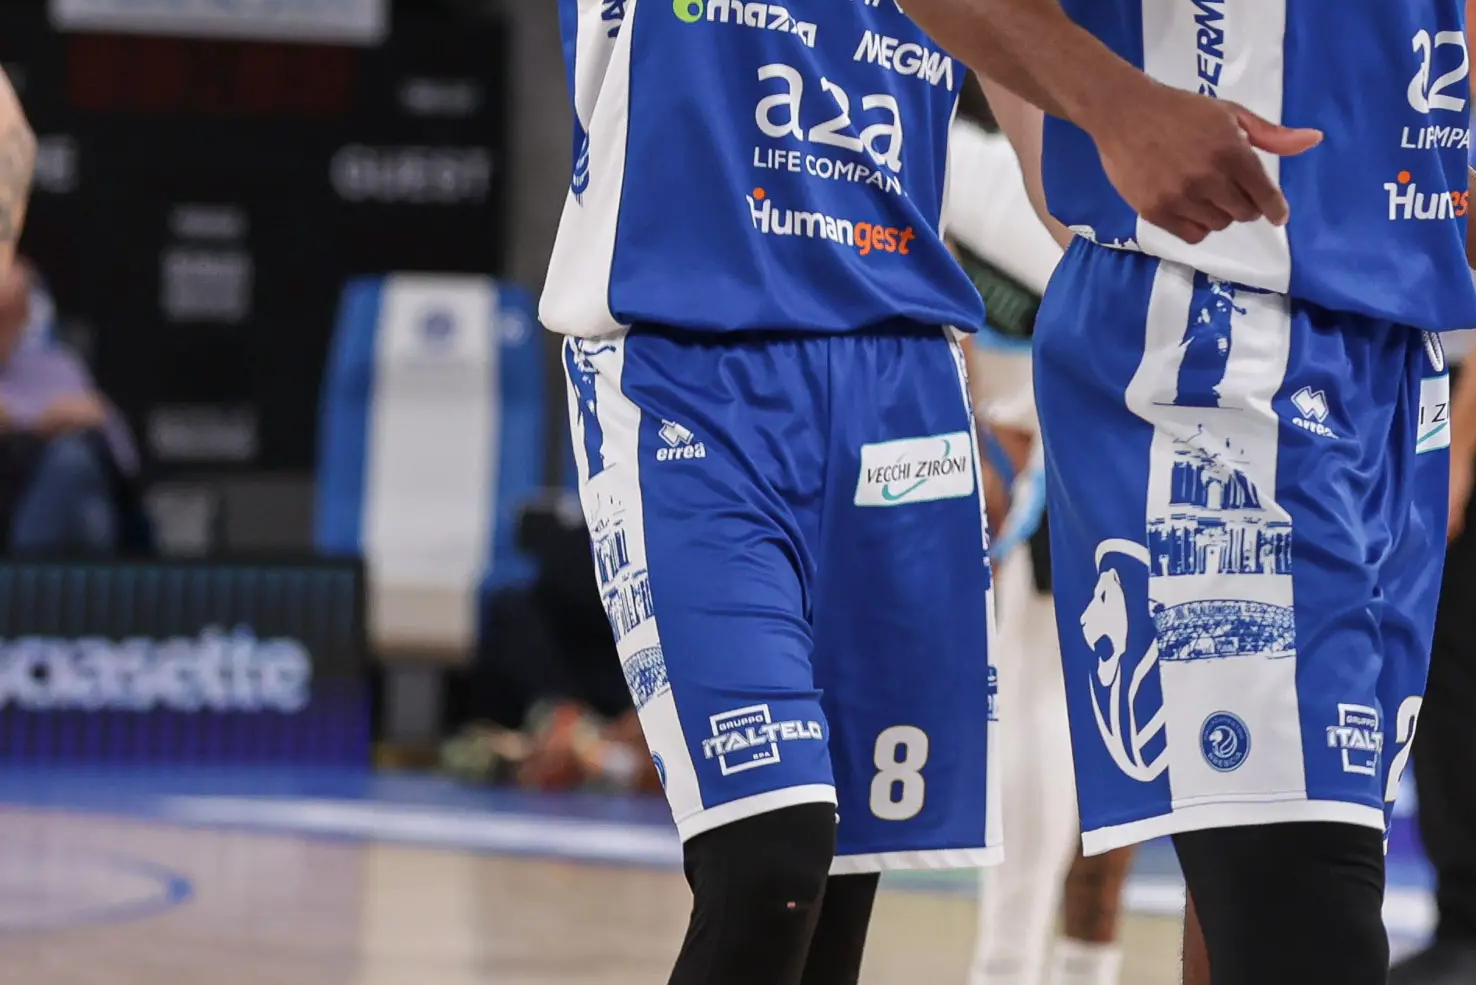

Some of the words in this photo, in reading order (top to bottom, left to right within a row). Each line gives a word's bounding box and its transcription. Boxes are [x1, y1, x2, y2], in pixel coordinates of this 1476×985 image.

[755, 62, 904, 173] a2a
[753, 146, 802, 173] LIFE
[805, 154, 909, 198] COMPAN
[745, 187, 917, 256] Humangest
[867, 462, 911, 484] VECCHI
[914, 456, 967, 479] ZIRONI
[718, 714, 764, 732] GRUPPO
[868, 725, 929, 821] 8
